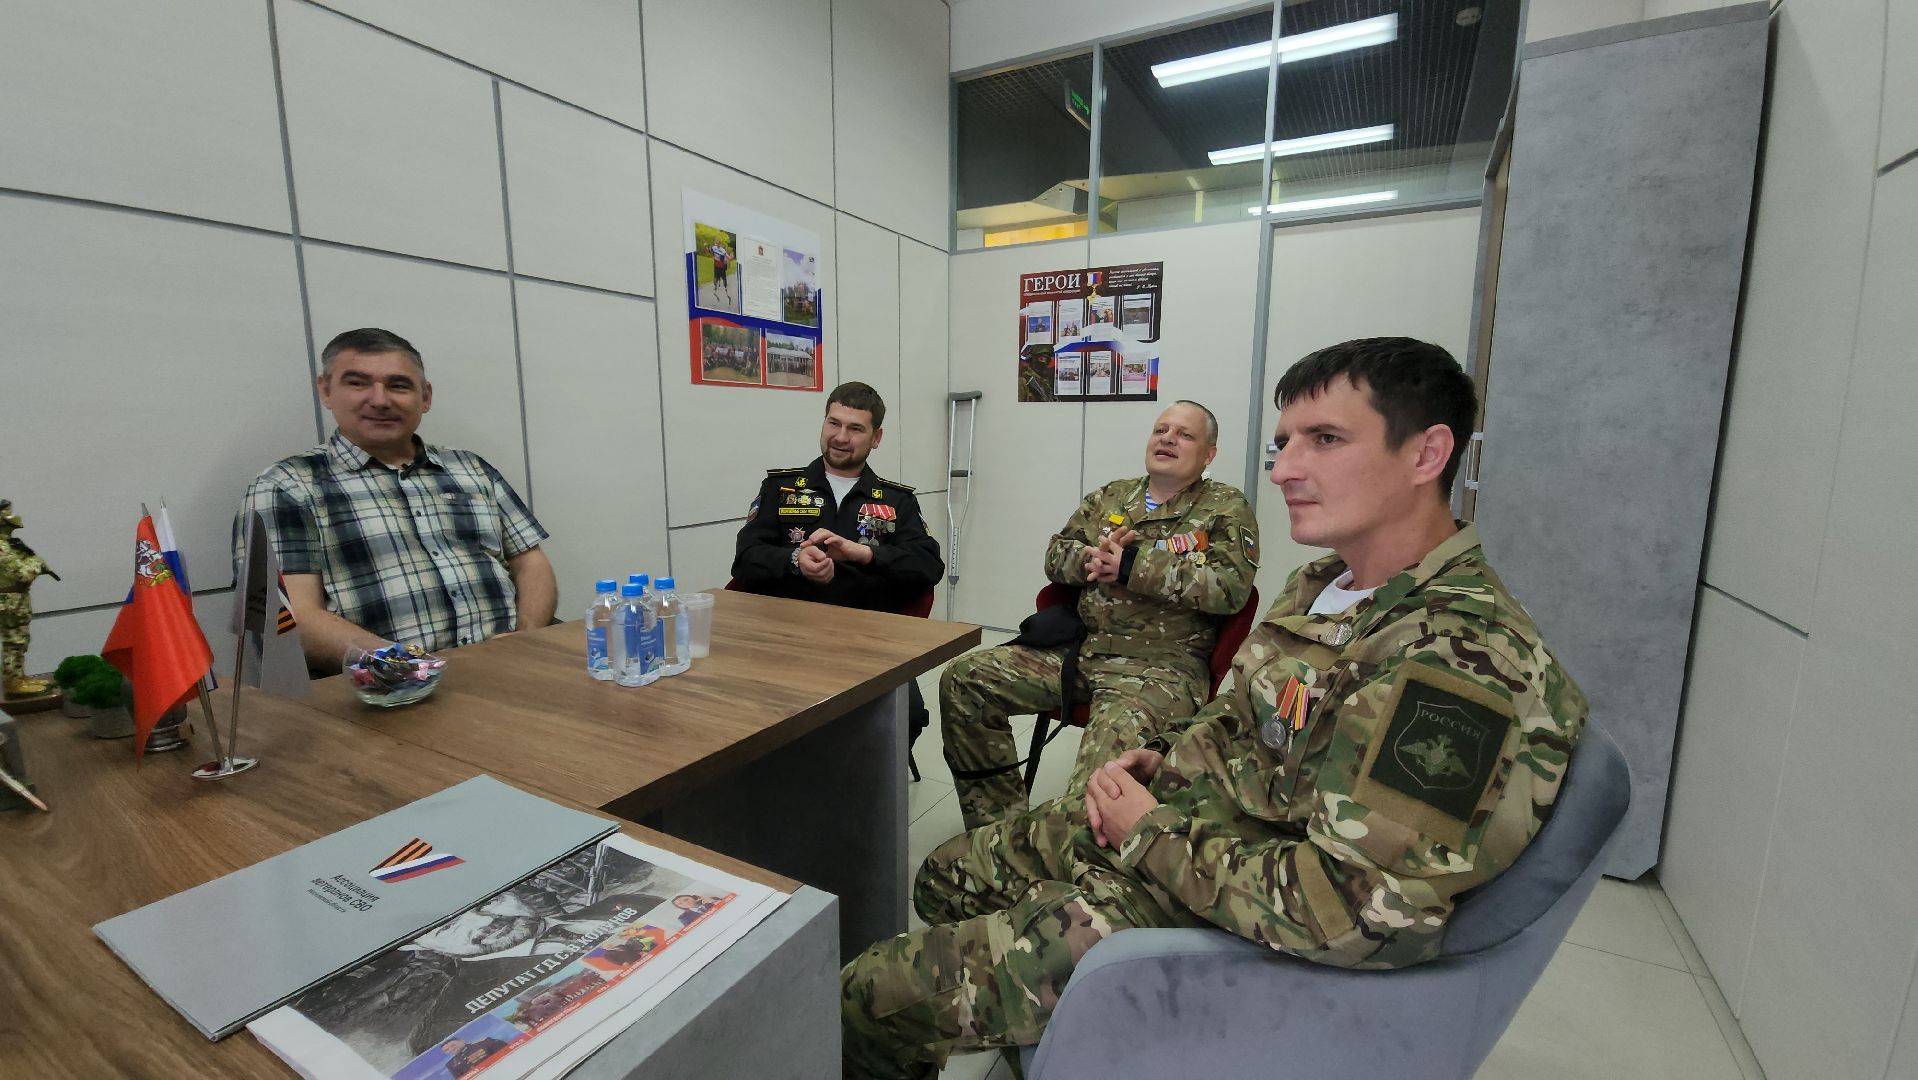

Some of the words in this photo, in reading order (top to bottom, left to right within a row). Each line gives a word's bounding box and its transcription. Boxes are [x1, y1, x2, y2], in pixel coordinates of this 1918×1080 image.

[1023, 273, 1081, 292] ГЕРОИ
[1421, 709, 1480, 739] РОССИЯ
[349, 899, 373, 912] СВО
[465, 969, 536, 1014] ДЕПУТАТ
